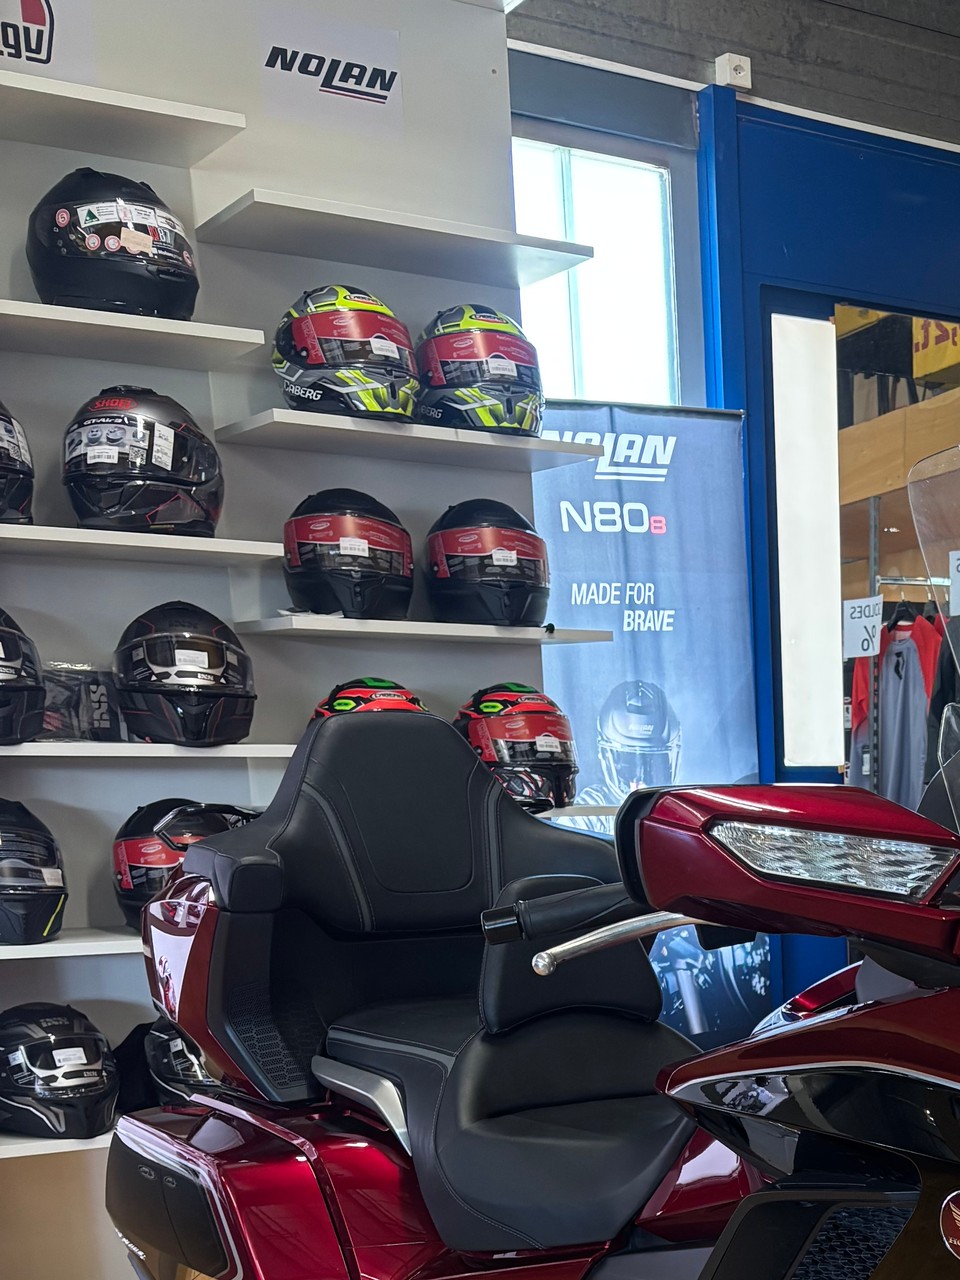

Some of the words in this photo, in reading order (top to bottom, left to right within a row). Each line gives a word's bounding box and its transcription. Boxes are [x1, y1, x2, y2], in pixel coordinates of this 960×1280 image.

[0, 21, 45, 59] gv
[264, 45, 398, 101] NOLAN
[283, 380, 323, 401] CABERG
[571, 582, 622, 606] MADE
[625, 582, 655, 605] FOR
[623, 609, 676, 632] BRAVE
